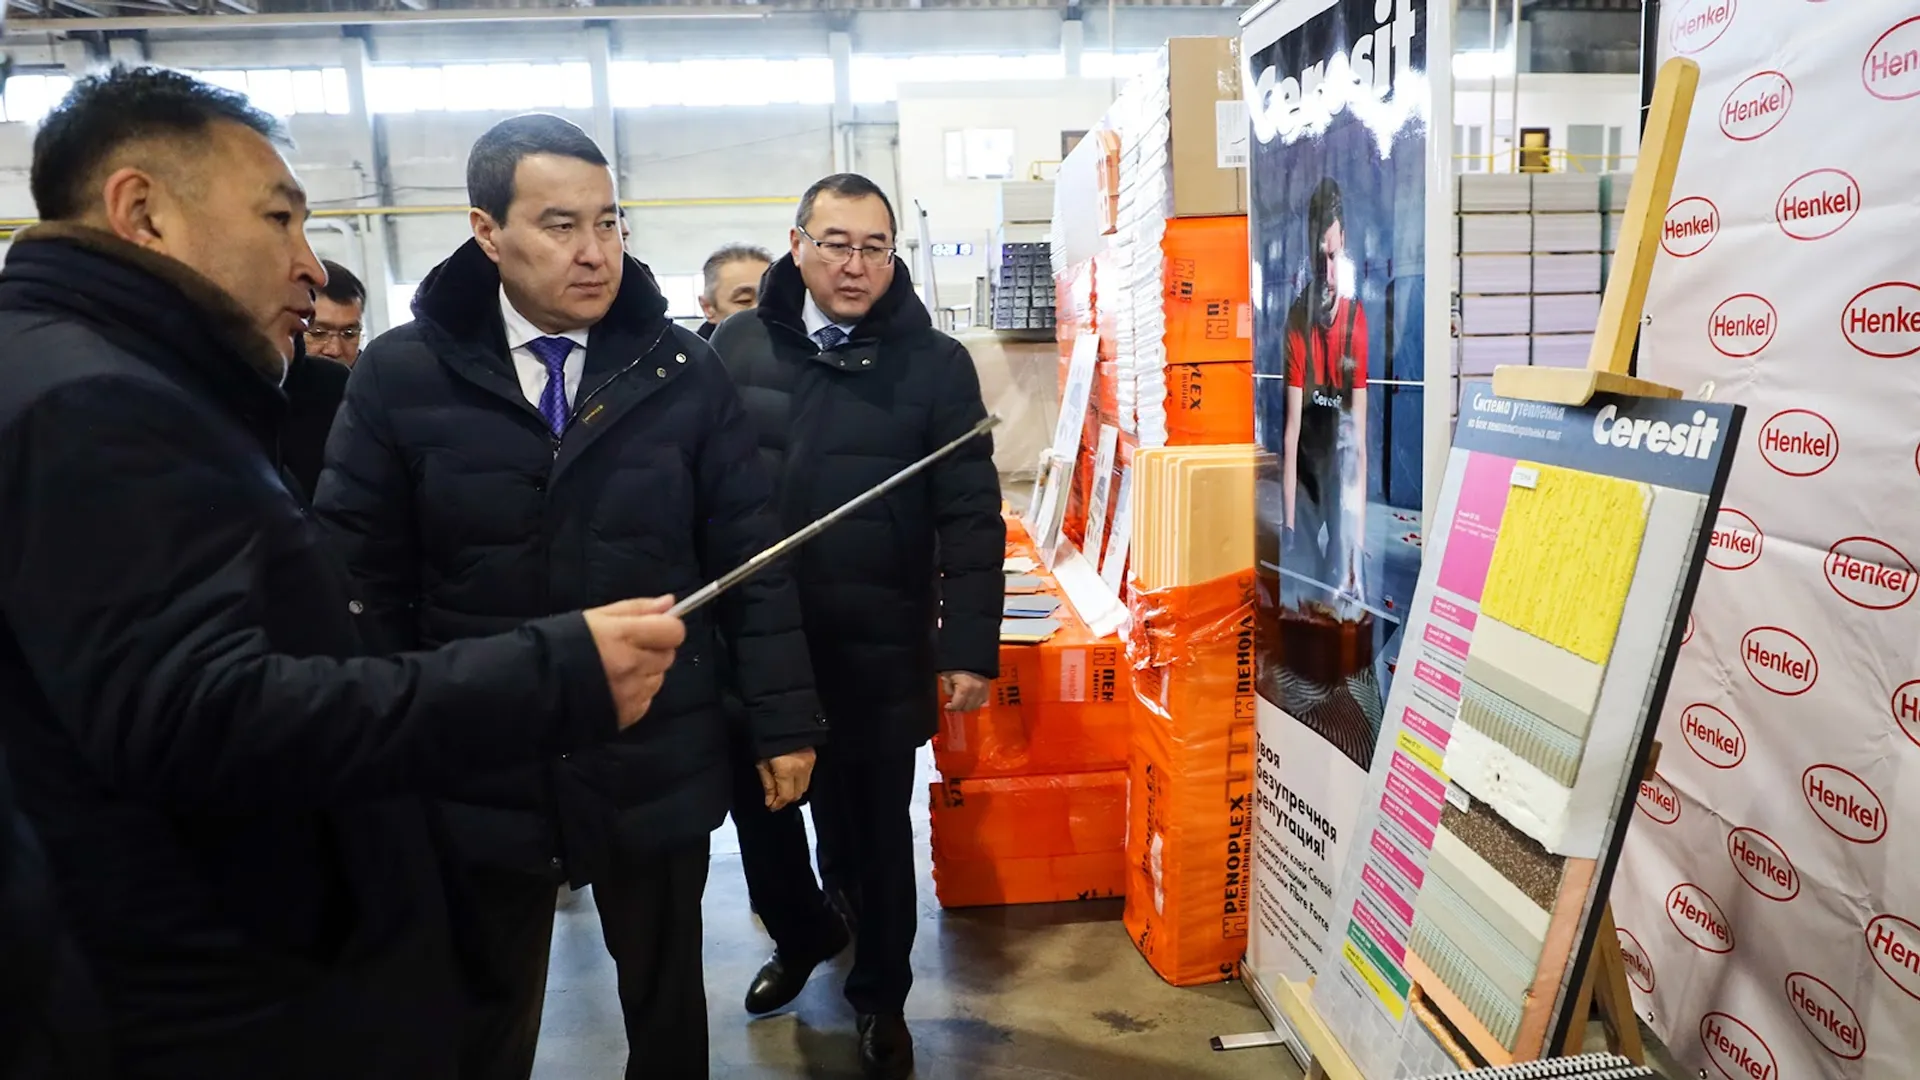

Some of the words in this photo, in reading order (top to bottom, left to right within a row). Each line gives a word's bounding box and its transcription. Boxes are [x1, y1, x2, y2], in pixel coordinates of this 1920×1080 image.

[1675, 3, 1730, 40] Henkel
[1871, 50, 1919, 82] Hen
[1725, 85, 1785, 124] Henkel
[1783, 186, 1852, 221] Henkel
[1665, 212, 1714, 240] Henkel
[1714, 313, 1770, 337] Henkel
[1850, 306, 1920, 333] Henke
[1473, 392, 1511, 415] Система
[1511, 402, 1565, 421] утепления
[1593, 404, 1719, 460] Ceresit
[1765, 427, 1830, 457] Henkel
[1709, 529, 1758, 555] enkel
[1832, 552, 1910, 592] Henkel
[1747, 639, 1811, 682] Henkel
[1257, 732, 1280, 769] Твоя
[1686, 713, 1739, 757] Henkel
[1257, 758, 1337, 844] безупречная
[1640, 780, 1675, 814] enkel
[1810, 775, 1879, 831] Henkel
[1257, 788, 1325, 861] репутация!
[1224, 794, 1245, 915] PENOPLEX
[1733, 836, 1792, 891] Henkel
[1289, 883, 1308, 909] Fibre
[1308, 867, 1332, 900] Ceresit
[1672, 891, 1730, 944] Henkel
[1620, 948, 1651, 985] enkel
[1873, 924, 1920, 977] Hen
[1791, 981, 1858, 1050] Henkel
[1706, 1019, 1771, 1080] Henkel
